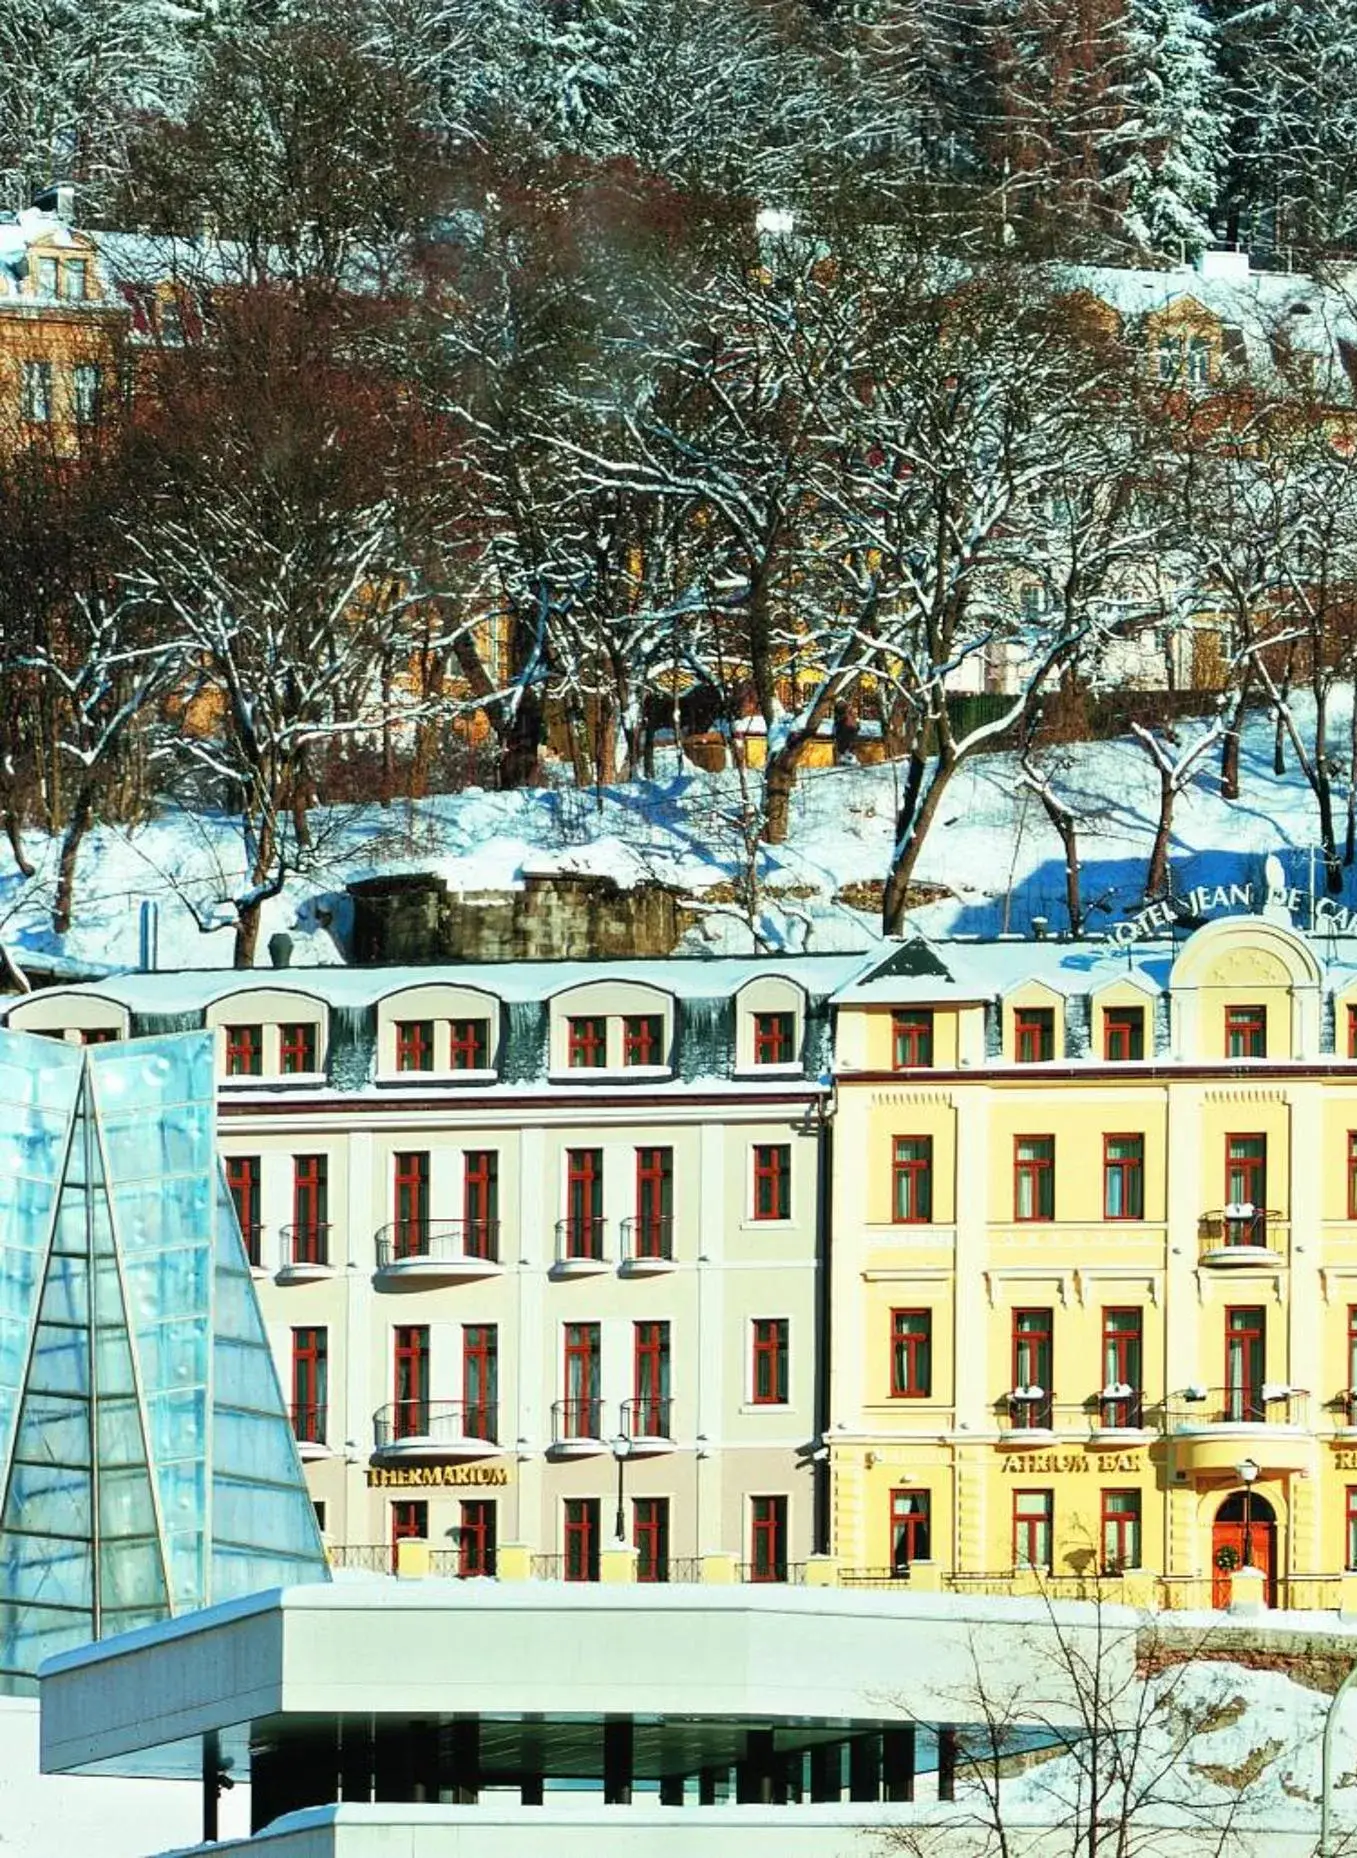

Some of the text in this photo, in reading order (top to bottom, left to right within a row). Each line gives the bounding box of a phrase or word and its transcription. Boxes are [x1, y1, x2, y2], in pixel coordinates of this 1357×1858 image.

[1102, 900, 1179, 959] HOTEL
[1187, 882, 1254, 917] JEAN
[1267, 887, 1307, 911] DE
[1002, 1454, 1142, 1473] ATRIUM BAR
[364, 1465, 511, 1487] THERMARIUM
